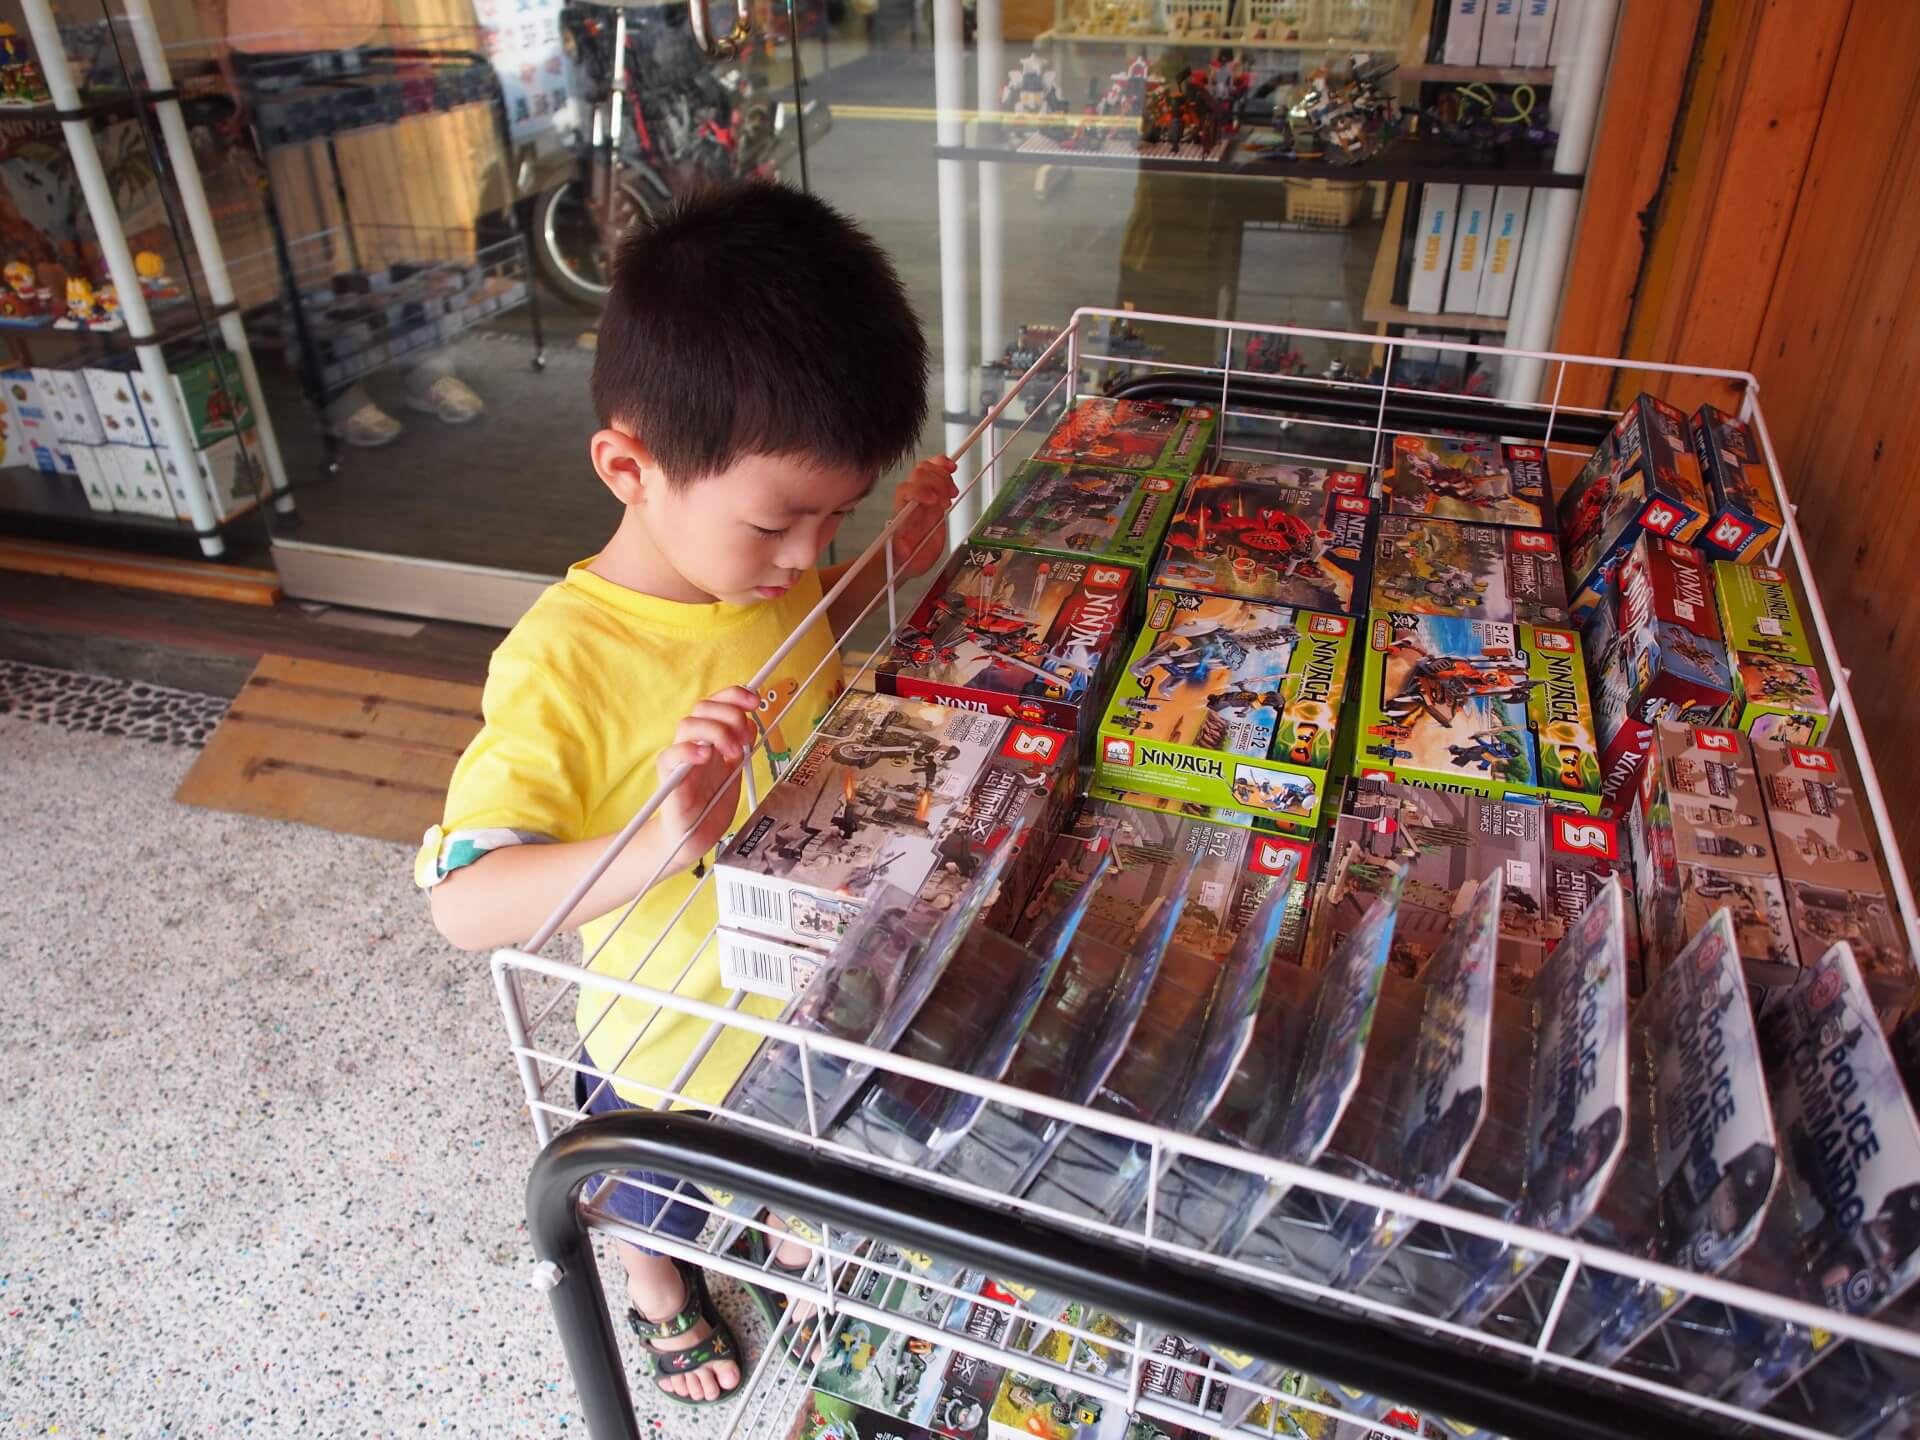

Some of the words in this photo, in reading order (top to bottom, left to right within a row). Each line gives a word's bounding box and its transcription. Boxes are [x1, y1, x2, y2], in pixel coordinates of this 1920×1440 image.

[1526, 461, 1543, 488] NICK
[1333, 511, 1349, 548] KNIGHTS
[1348, 514, 1368, 550] NICK
[1068, 564, 1087, 583] 6-12
[1066, 588, 1119, 648] NINJA
[1250, 726, 1270, 750] 5-12
[1505, 808, 1524, 839] 6-12
[1208, 830, 1229, 859] 6-12
[1704, 1010, 1736, 1132] POLICE
[1820, 1044, 1881, 1172] POLICE
[1789, 1035, 1865, 1233] COMMANDO
